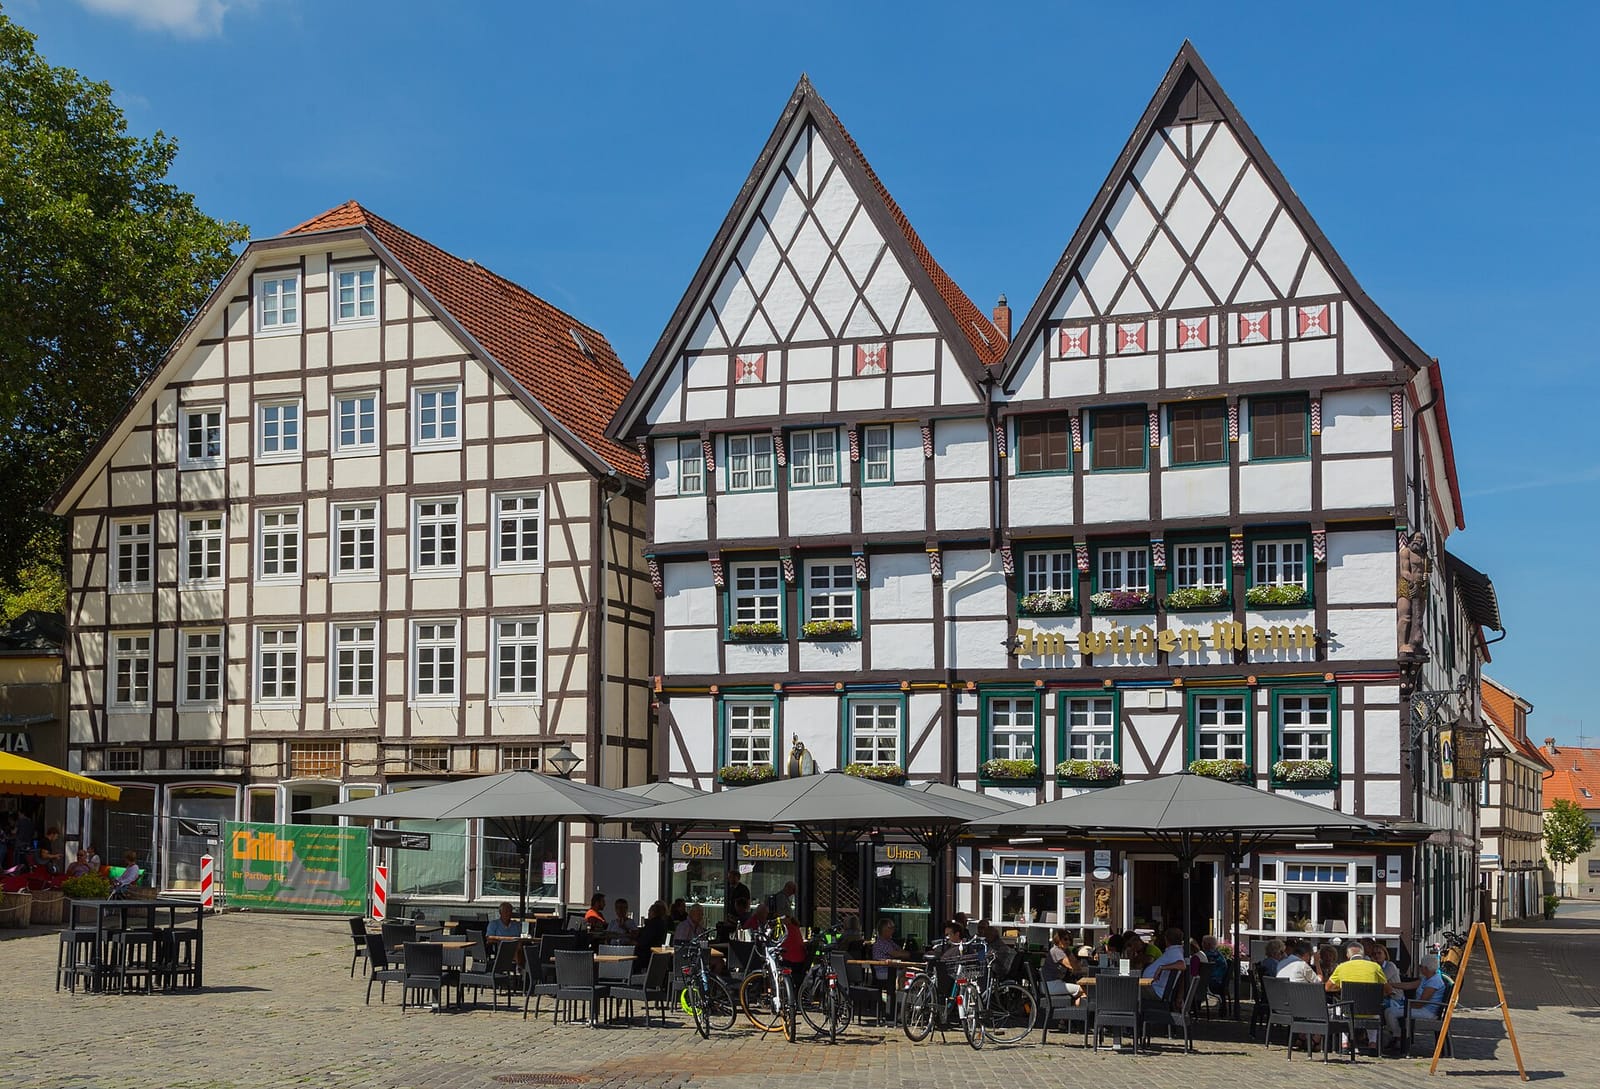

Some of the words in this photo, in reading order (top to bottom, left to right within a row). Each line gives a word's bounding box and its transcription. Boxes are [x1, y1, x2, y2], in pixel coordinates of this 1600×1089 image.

[1013, 627, 1065, 656] Im
[1077, 620, 1201, 656] wilden
[1211, 620, 1316, 653] Mann
[232, 831, 295, 862] Driller
[681, 842, 713, 858] Optik
[742, 844, 789, 858] Schmuck
[232, 871, 243, 879] Ihr
[244, 872, 272, 881] Partner
